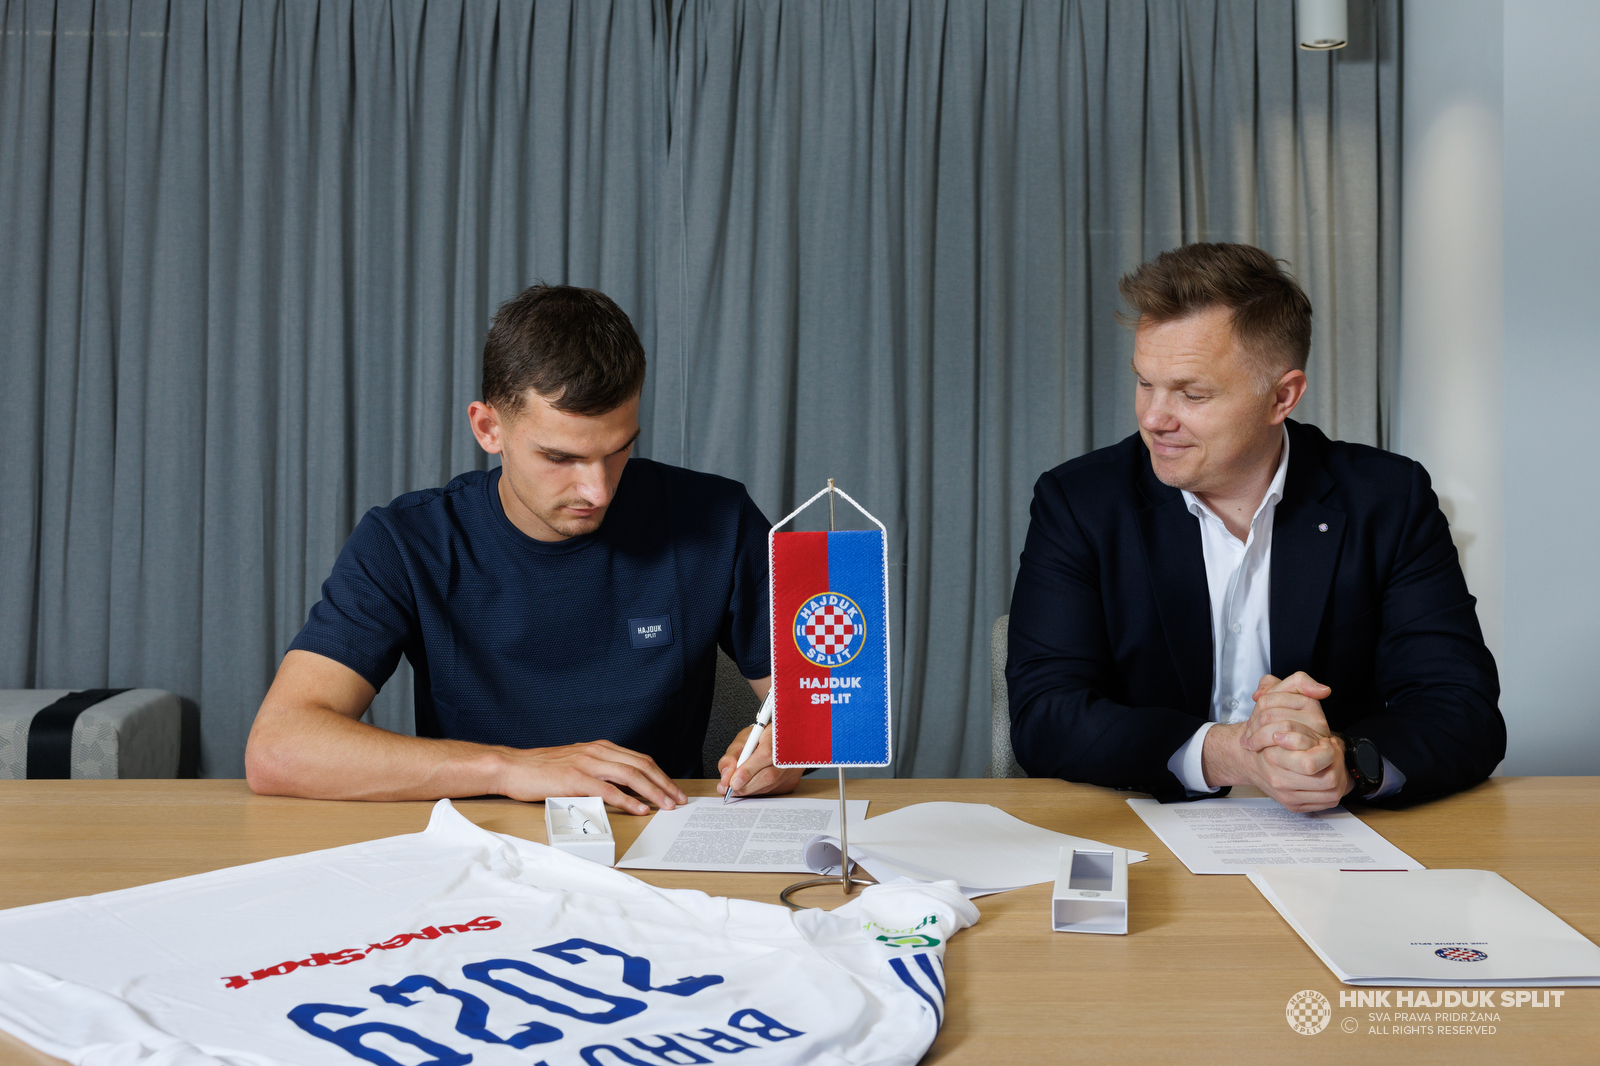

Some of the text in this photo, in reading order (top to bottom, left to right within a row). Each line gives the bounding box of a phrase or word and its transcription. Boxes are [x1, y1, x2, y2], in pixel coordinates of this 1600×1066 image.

[800, 595, 858, 619] HAJDUK
[637, 624, 662, 634] HAJDUK
[806, 648, 851, 664] SPLIT
[800, 677, 861, 689] HAJDUK
[811, 693, 851, 704] SPLIT
[286, 937, 725, 1066] 2029
[533, 1008, 807, 1066] BRAU
